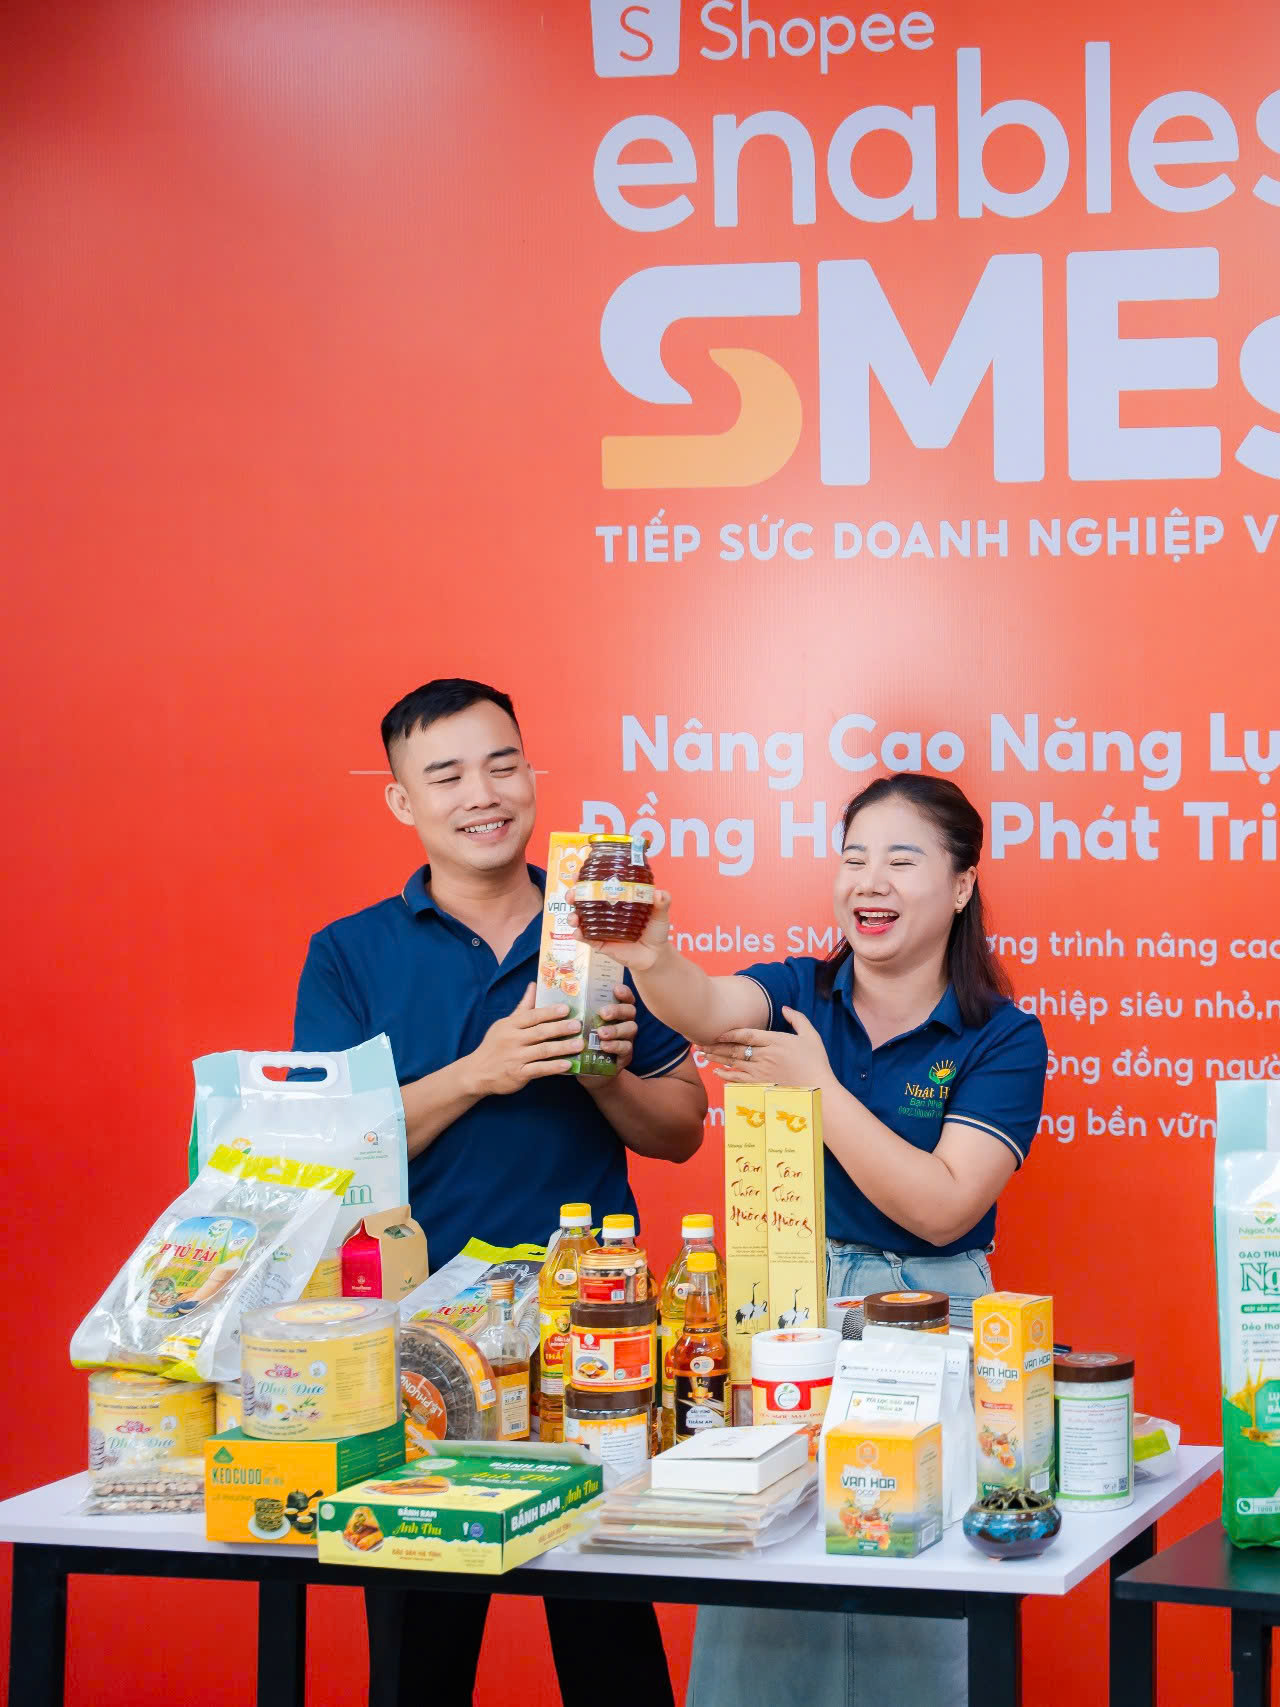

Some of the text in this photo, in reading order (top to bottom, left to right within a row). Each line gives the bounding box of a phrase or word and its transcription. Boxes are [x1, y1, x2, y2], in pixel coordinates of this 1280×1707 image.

[700, 0, 935, 74] Shopee
[596, 508, 701, 564] TIẾP
[719, 513, 814, 562] SỨC
[834, 519, 1009, 561] DOANH
[1028, 507, 1225, 564] NGHIỆP
[622, 714, 804, 791] Nâng
[829, 713, 965, 772] Cao
[991, 713, 1182, 791] Năng
[991, 802, 1160, 862] Phát
[668, 925, 776, 952] nables
[1049, 929, 1124, 957] trình
[1136, 932, 1217, 966] nâng
[1120, 991, 1183, 1017] siêu
[1112, 1046, 1193, 1086] đồng
[904, 1082, 935, 1099] Nhật
[1087, 1105, 1147, 1137] bền
[1157, 1112, 1217, 1138] vữn
[842, 1475, 896, 1489] VAN HOA
[511, 1496, 561, 1532] BÁNH RAM
